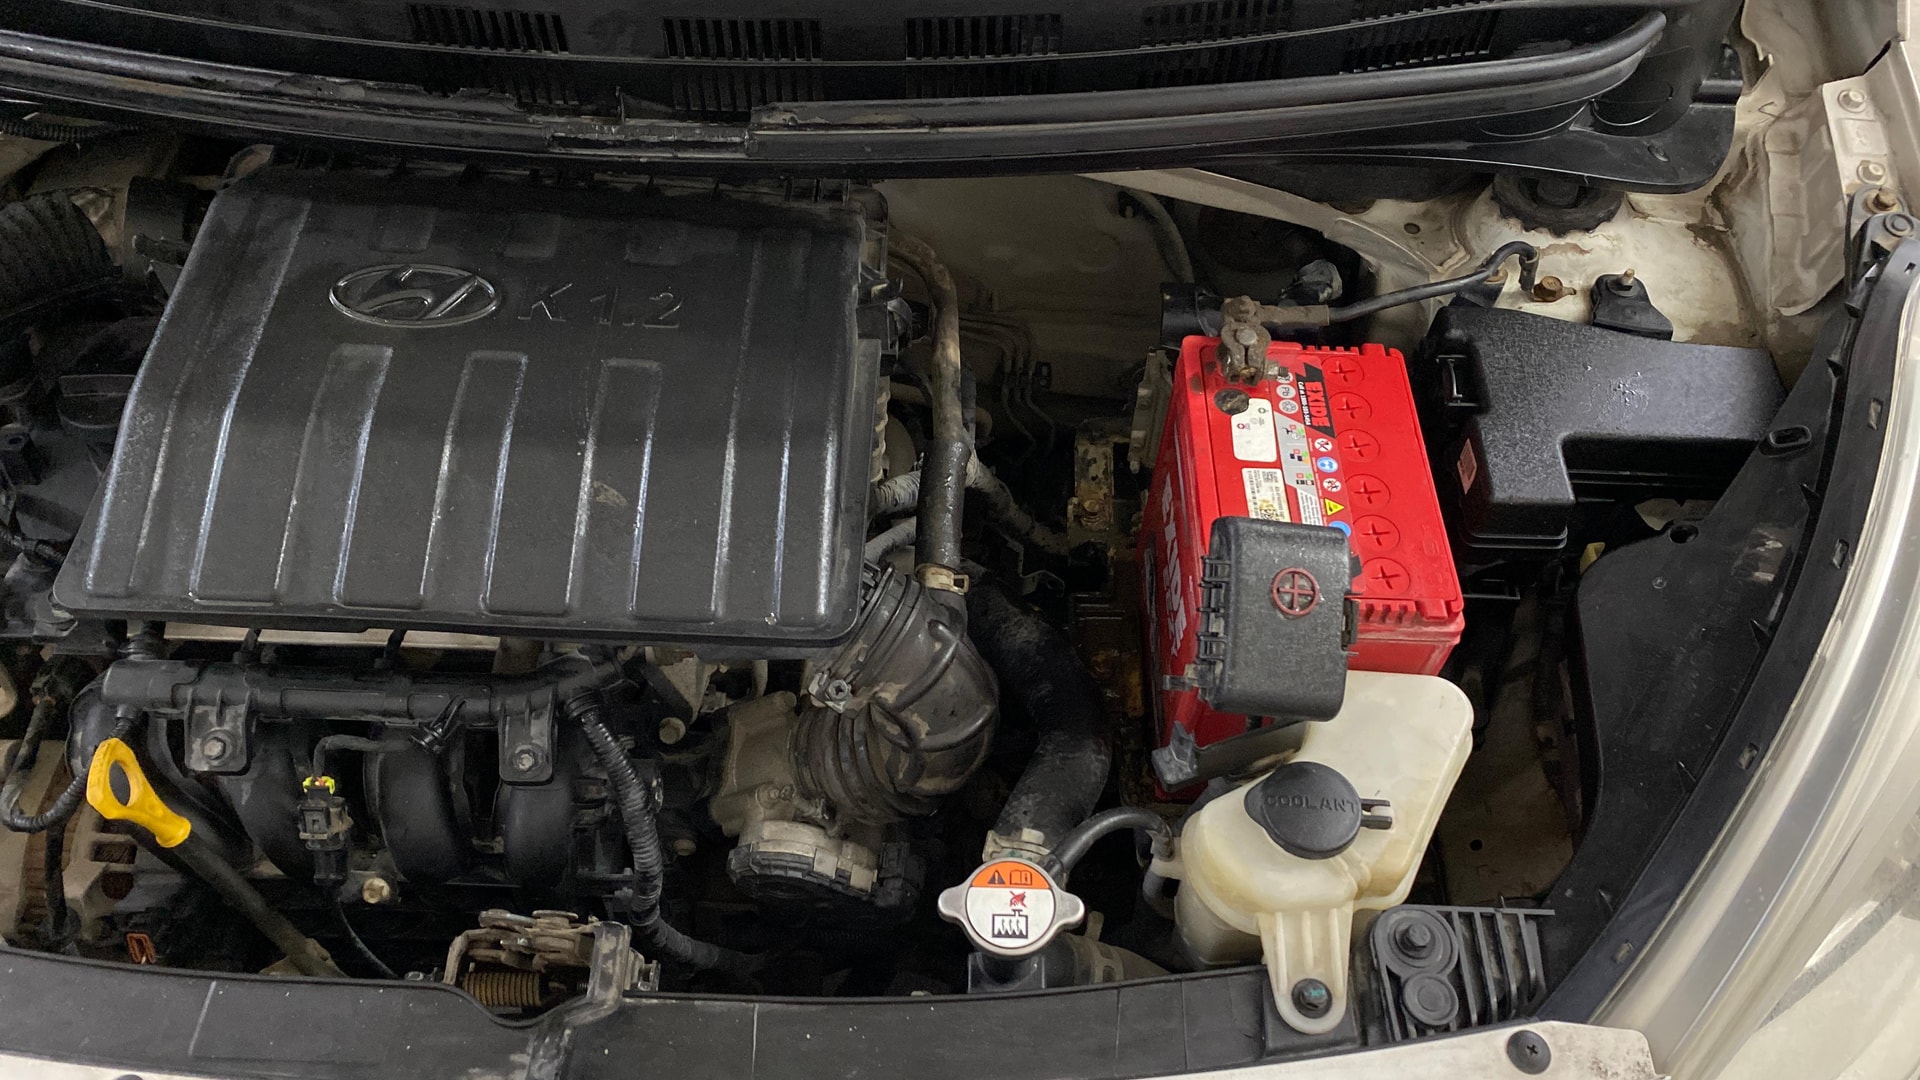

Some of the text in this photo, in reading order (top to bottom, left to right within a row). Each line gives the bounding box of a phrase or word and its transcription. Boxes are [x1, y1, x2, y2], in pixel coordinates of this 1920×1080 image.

[1281, 386, 1290, 397] Pb
[1305, 381, 1330, 427] EXIDE
[1162, 472, 1187, 650] EXIDE
[1266, 795, 1357, 814] COOLANT
